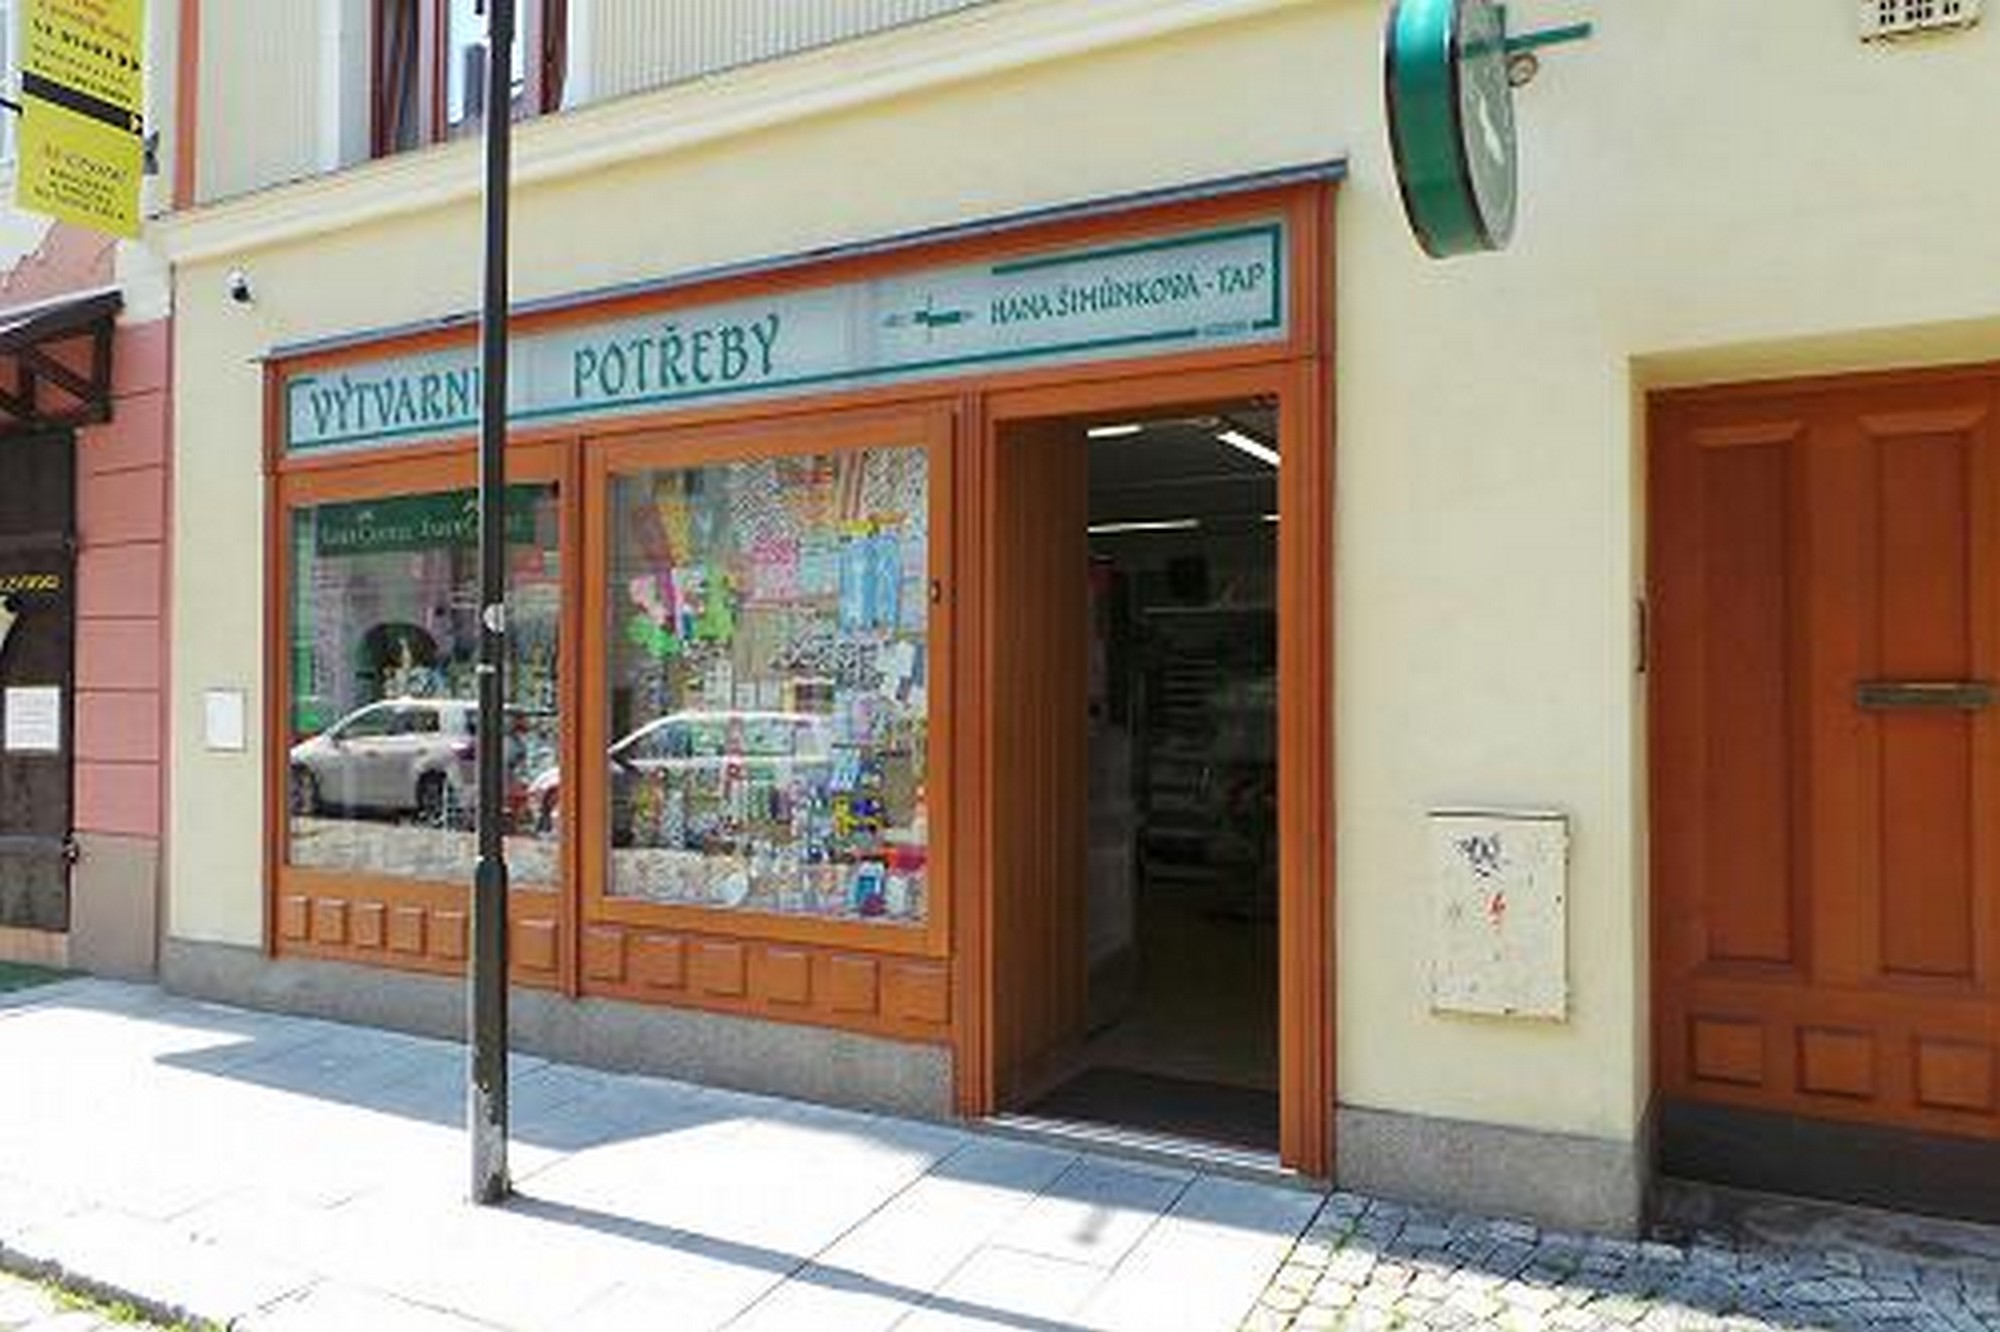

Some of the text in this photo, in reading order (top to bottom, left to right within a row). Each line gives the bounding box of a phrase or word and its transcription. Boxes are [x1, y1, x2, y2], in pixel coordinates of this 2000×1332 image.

[991, 294, 1052, 325] HANA
[1217, 262, 1266, 294] TAP
[573, 314, 779, 399] POTŘEBY
